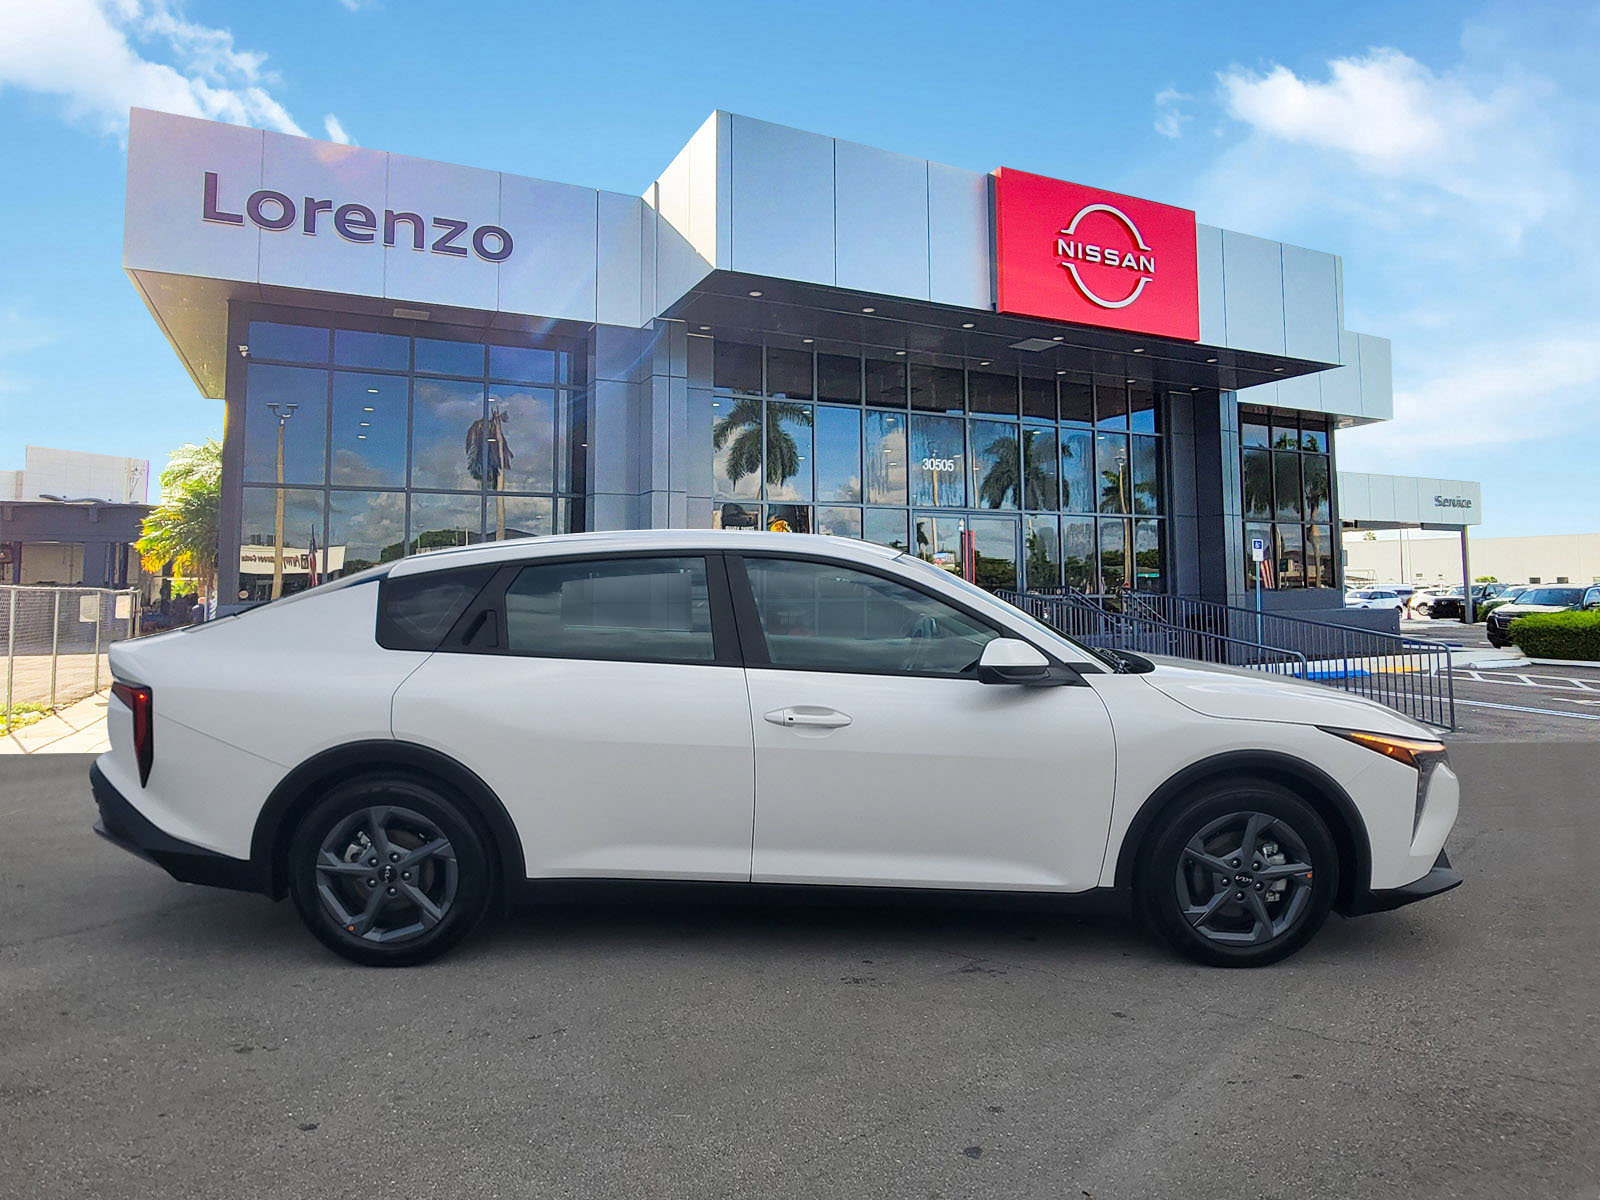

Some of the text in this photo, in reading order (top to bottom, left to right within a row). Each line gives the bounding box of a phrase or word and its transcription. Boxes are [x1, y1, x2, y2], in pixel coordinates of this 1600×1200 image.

[202, 171, 514, 262] Lorenzo
[1057, 238, 1155, 273] NISSAN
[922, 458, 954, 472] 30505
[1434, 495, 1472, 509] Service
